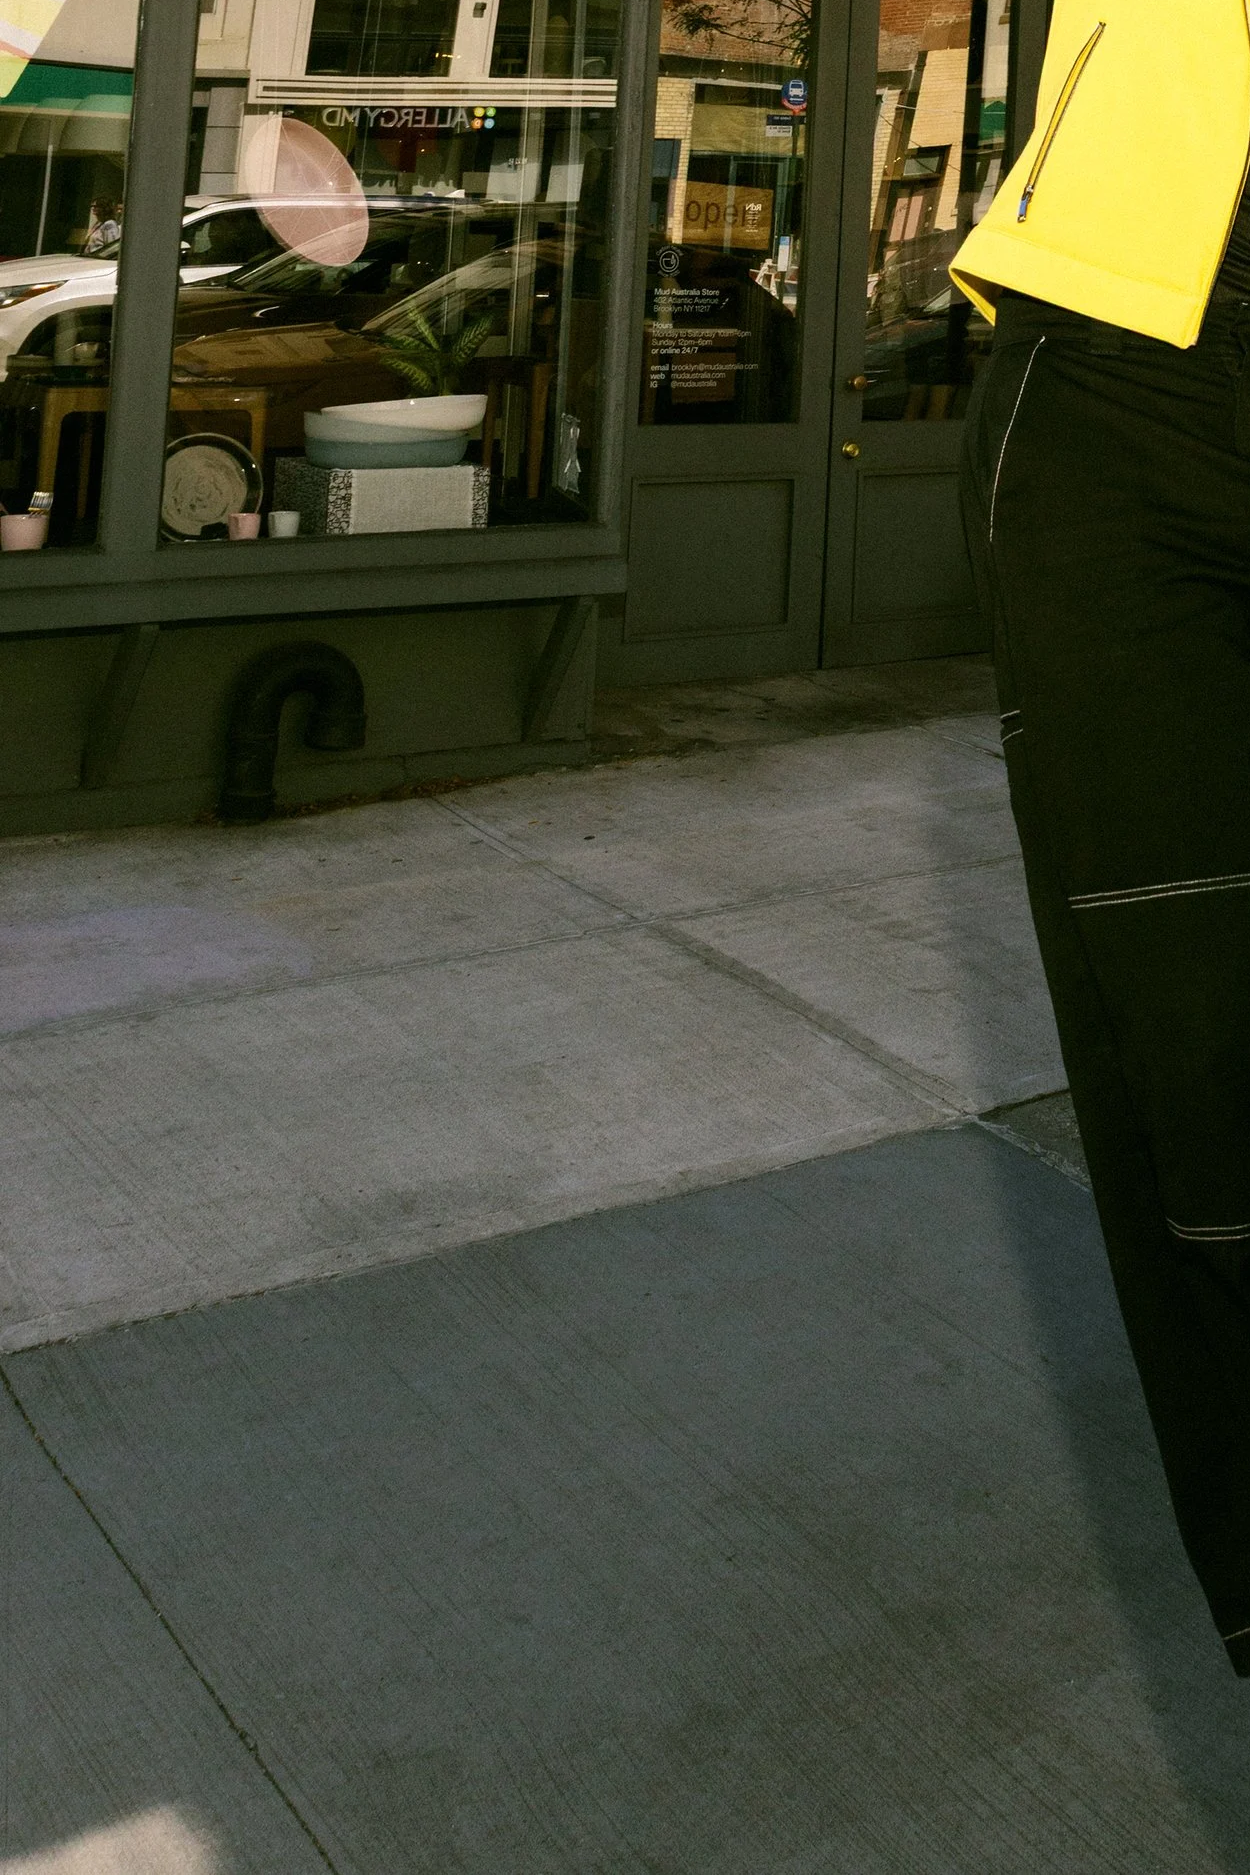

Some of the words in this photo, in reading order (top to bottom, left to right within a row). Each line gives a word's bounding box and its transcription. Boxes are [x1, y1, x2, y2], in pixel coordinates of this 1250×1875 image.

[654, 288, 670, 296] Mud
[671, 288, 701, 296] Australia
[702, 288, 720, 297] Store
[694, 297, 719, 305] Avenue
[653, 305, 682, 314] Brooklyn
[652, 321, 673, 329] Hours
[652, 330, 679, 339] Monday
[687, 330, 716, 339] Saturday
[652, 338, 677, 347] Sunday
[650, 372, 666, 380] web
